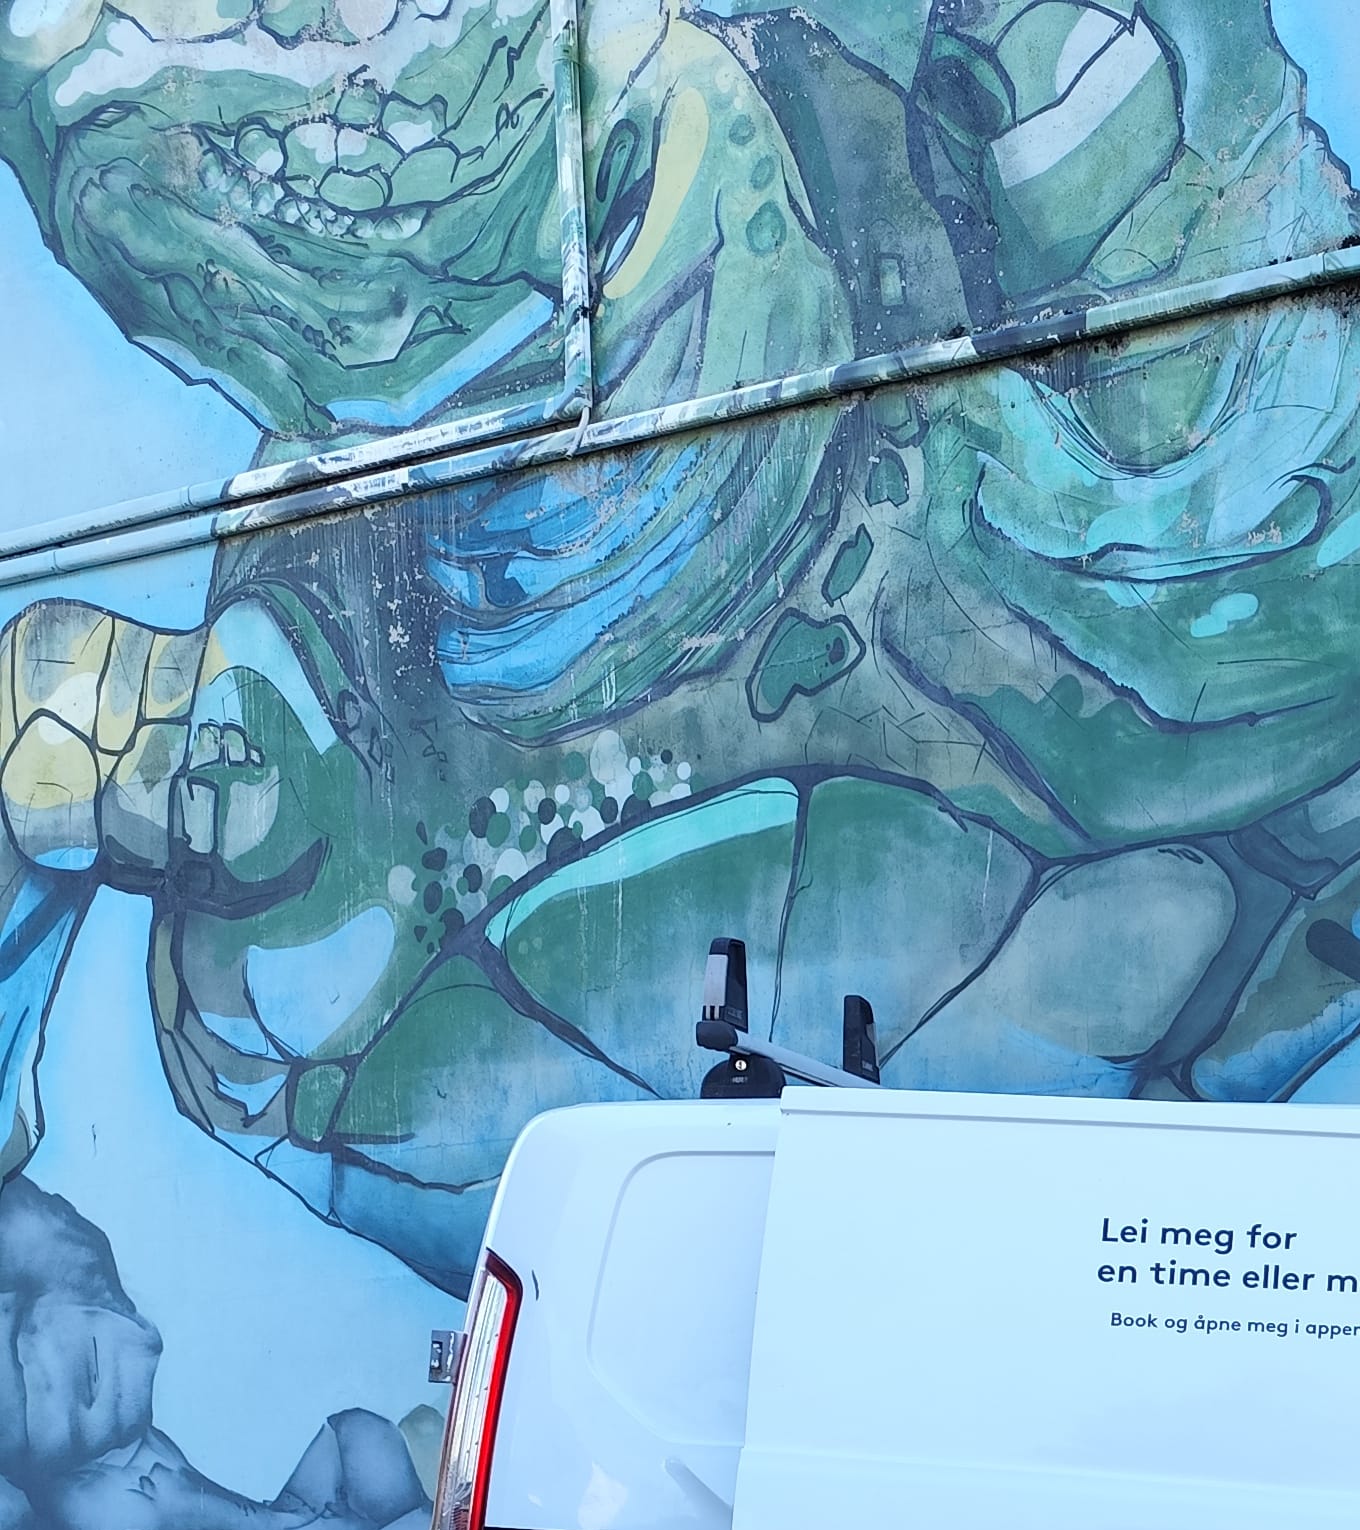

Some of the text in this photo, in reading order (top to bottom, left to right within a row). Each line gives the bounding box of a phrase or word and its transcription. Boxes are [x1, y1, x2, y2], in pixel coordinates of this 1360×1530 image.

[1102, 1217, 1298, 1255] Lei meg for
[1098, 1264, 1137, 1284] en
[1150, 1259, 1231, 1288] time
[1243, 1264, 1316, 1291] eller
[1110, 1312, 1158, 1329] Book
[1164, 1318, 1188, 1334] og
[1194, 1314, 1242, 1335] åpne
[1248, 1321, 1288, 1338] meg
[1294, 1318, 1300, 1334] i
